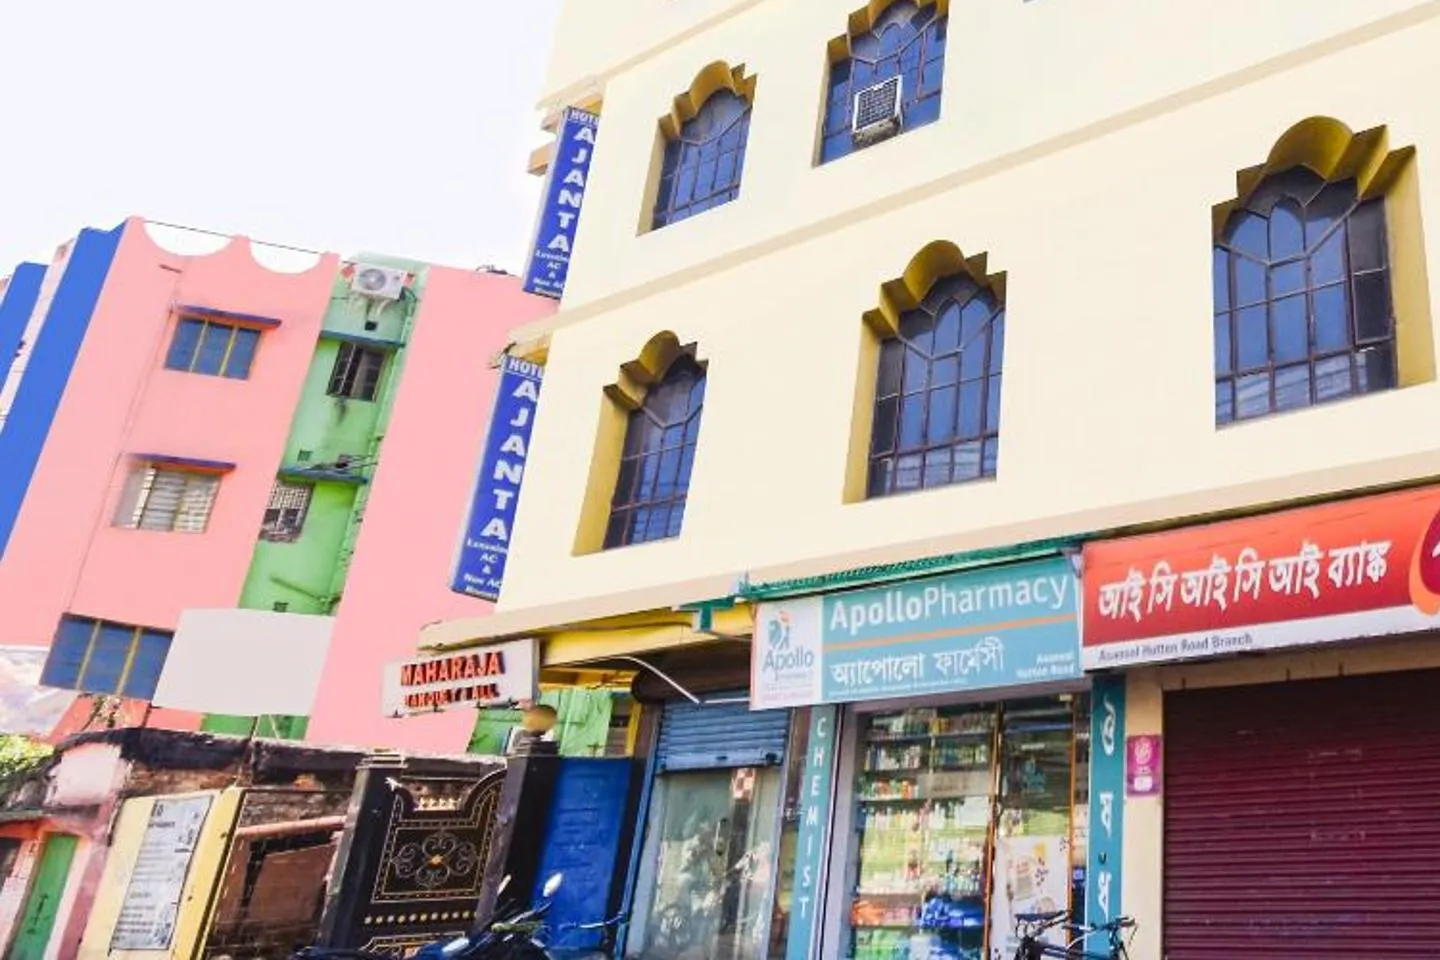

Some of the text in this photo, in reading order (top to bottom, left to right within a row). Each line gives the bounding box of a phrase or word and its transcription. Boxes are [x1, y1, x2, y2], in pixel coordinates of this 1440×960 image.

[548, 126, 595, 252] AJANTA
[480, 379, 539, 540] AJANTA
[1098, 568, 1146, 622] আই
[1147, 561, 1178, 614] সি
[1180, 554, 1231, 612] আই
[1234, 547, 1266, 603] সি
[1269, 540, 1324, 600] আই
[400, 650, 506, 687] MAHARAJA
[762, 644, 815, 681] Apollo
[799, 716, 827, 919] CHEMIST
